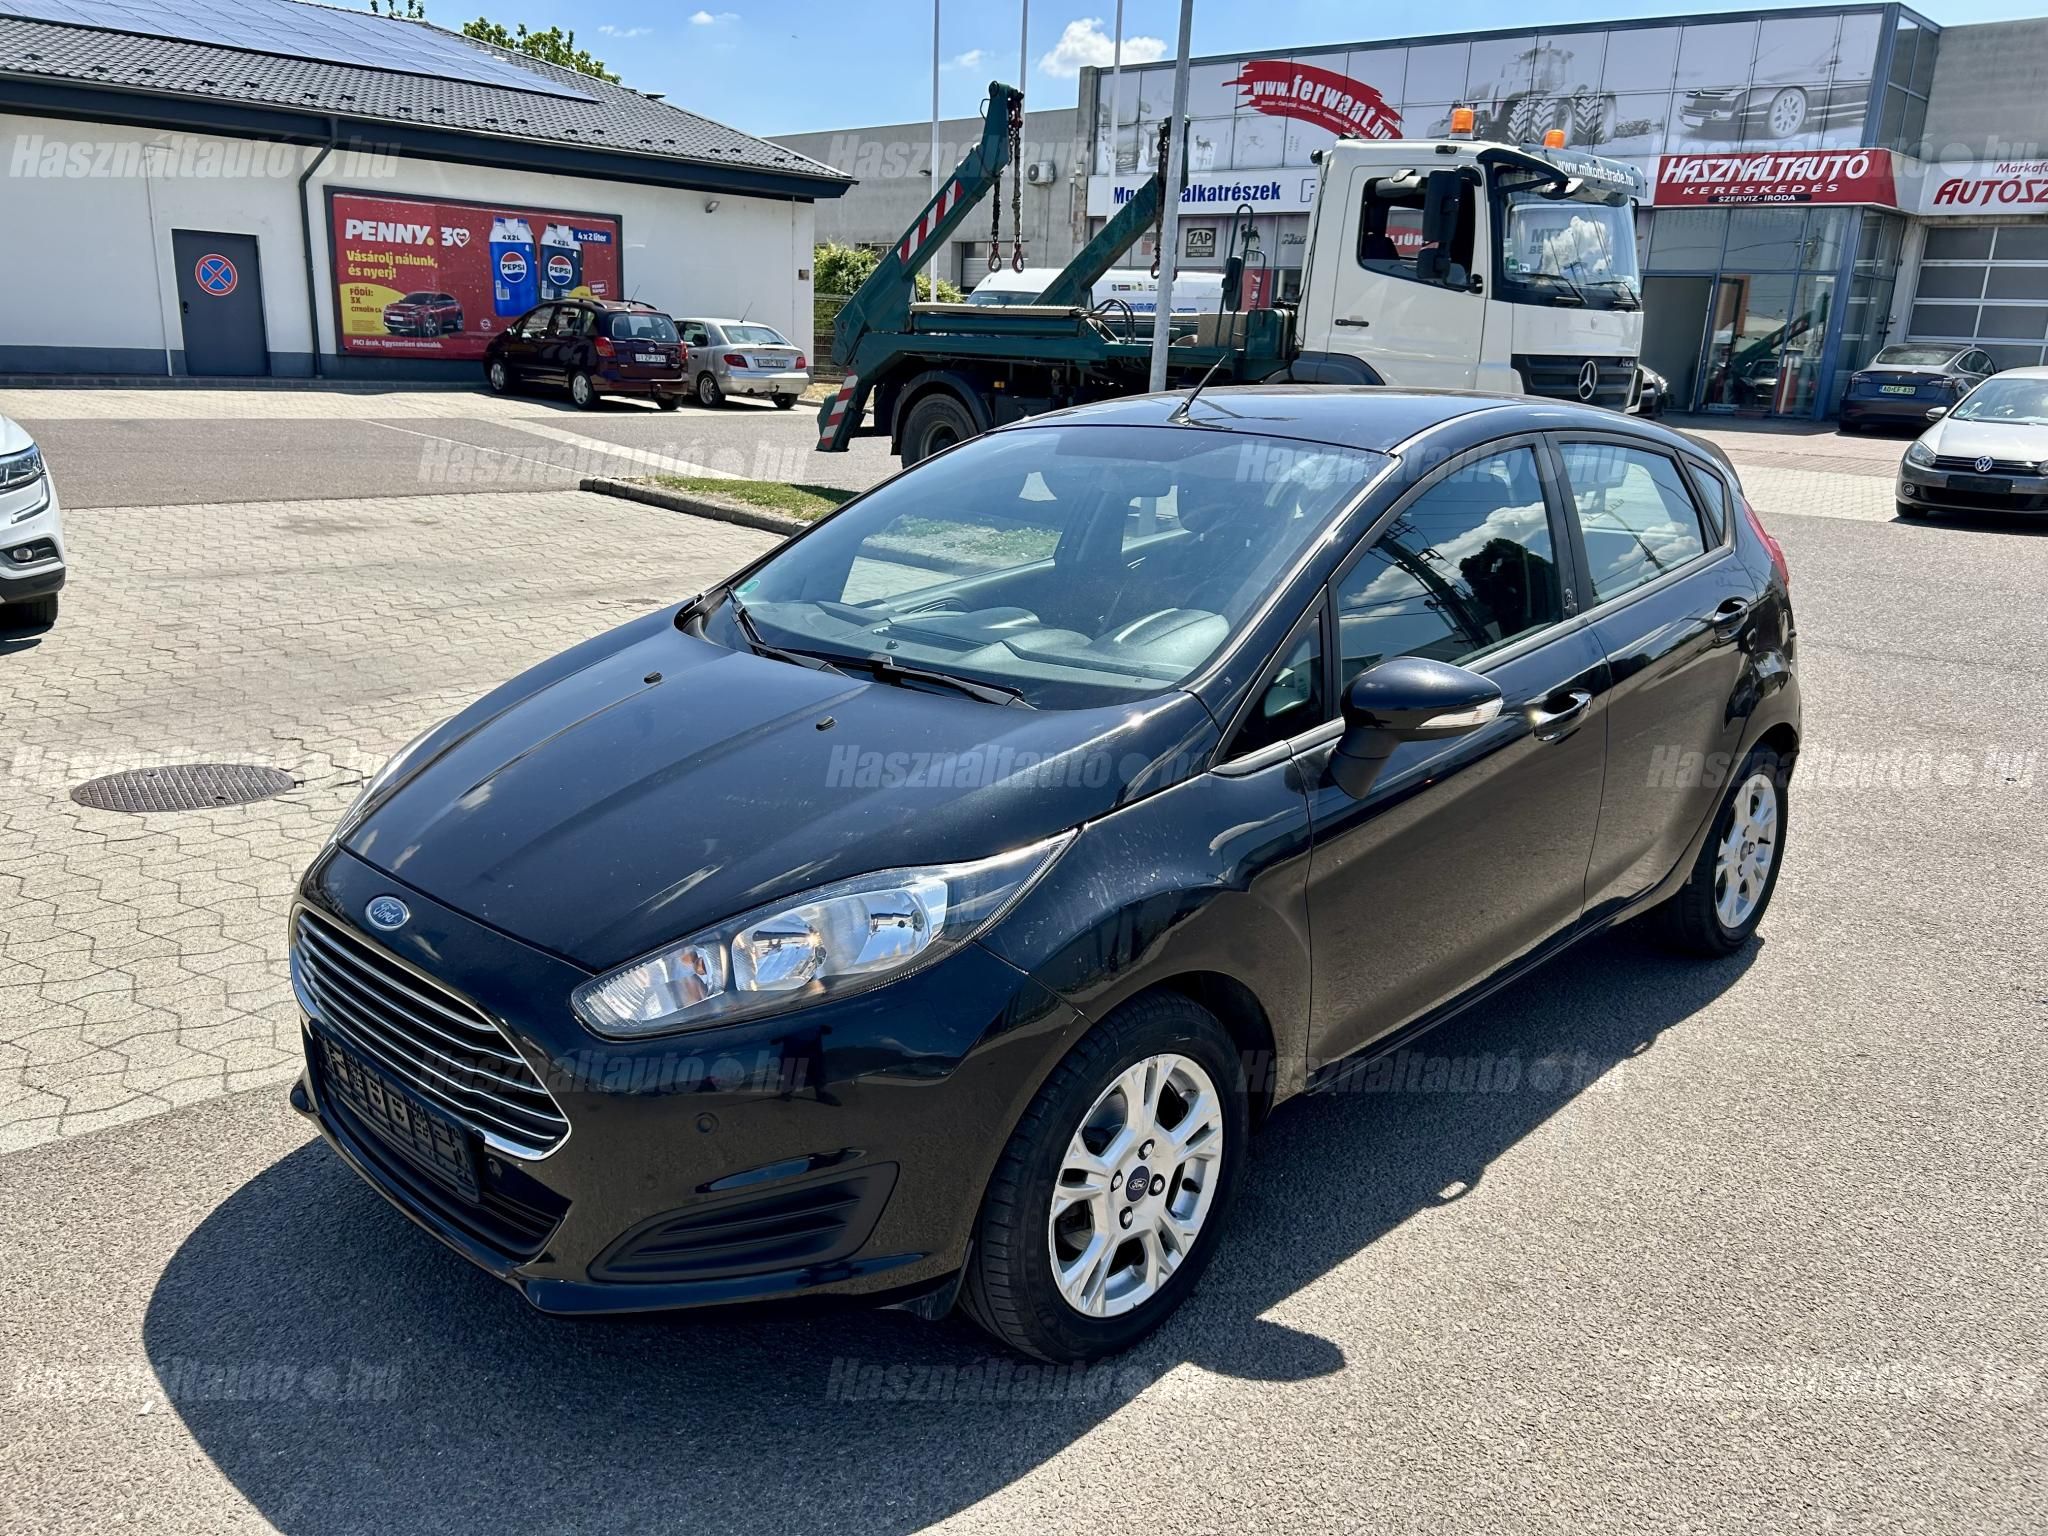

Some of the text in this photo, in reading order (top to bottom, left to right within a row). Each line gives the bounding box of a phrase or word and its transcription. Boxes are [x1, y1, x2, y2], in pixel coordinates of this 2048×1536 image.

[1252, 74, 1393, 139] www.ferwant.hu
[1661, 151, 1870, 184] HASZNÁLTAUTÓ
[1682, 183, 1839, 195] KERESKEDÉS
[1189, 231, 1212, 245] ZAP
[346, 249, 438, 269] Vásárolj nálunk,
[502, 262, 525, 272] PEPSI
[348, 263, 397, 280] és nyerj!
[549, 265, 571, 275] PEPSI
[374, 902, 400, 923] Ford
